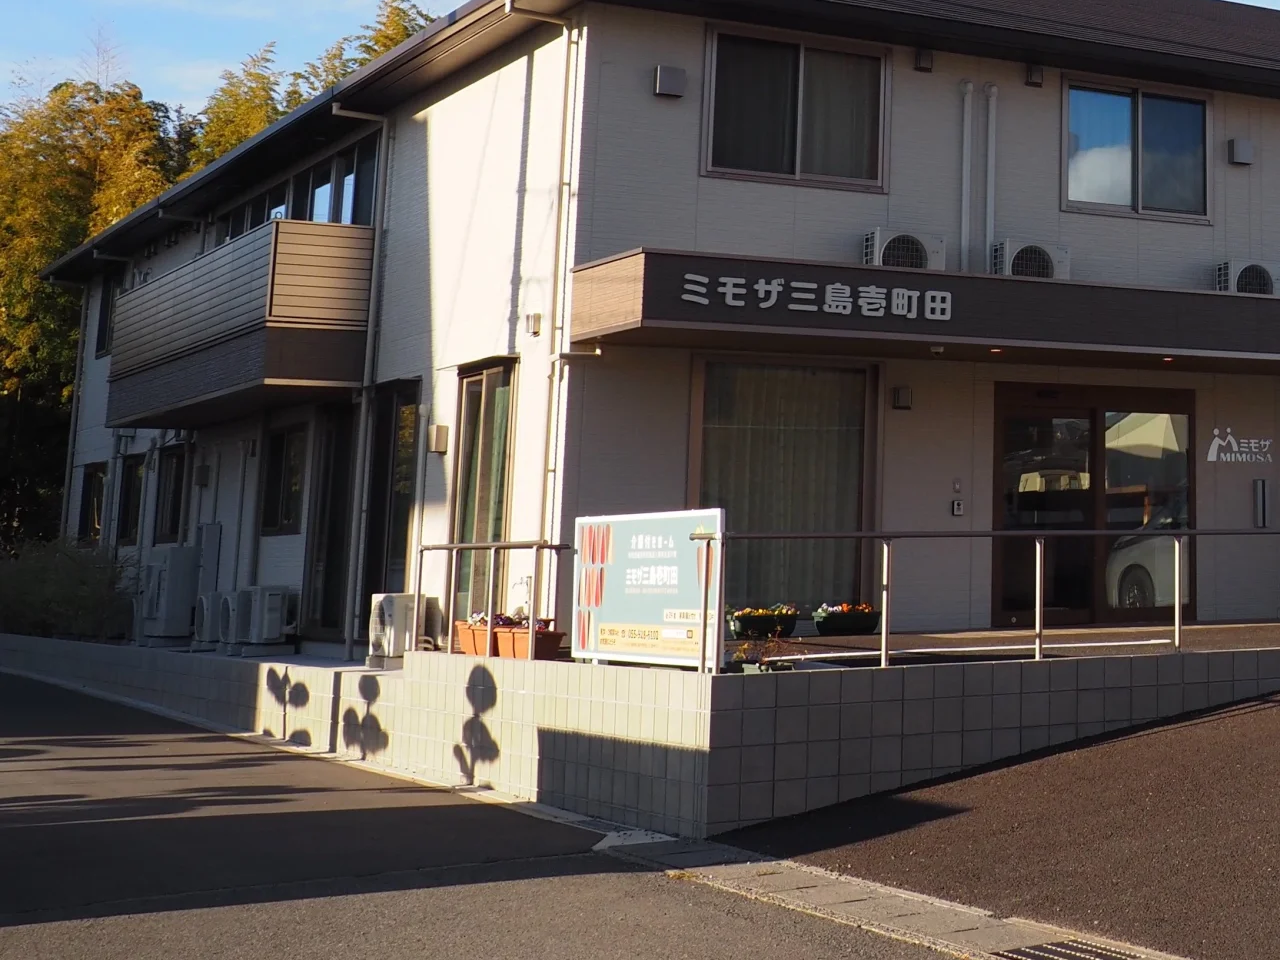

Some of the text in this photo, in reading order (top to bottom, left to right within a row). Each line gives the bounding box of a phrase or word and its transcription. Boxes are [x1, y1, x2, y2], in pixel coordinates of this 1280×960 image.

[681, 272, 952, 321] ミモザ三島壱町田
[1239, 438, 1274, 452] ミモザ
[1220, 452, 1274, 463] MIMOSA
